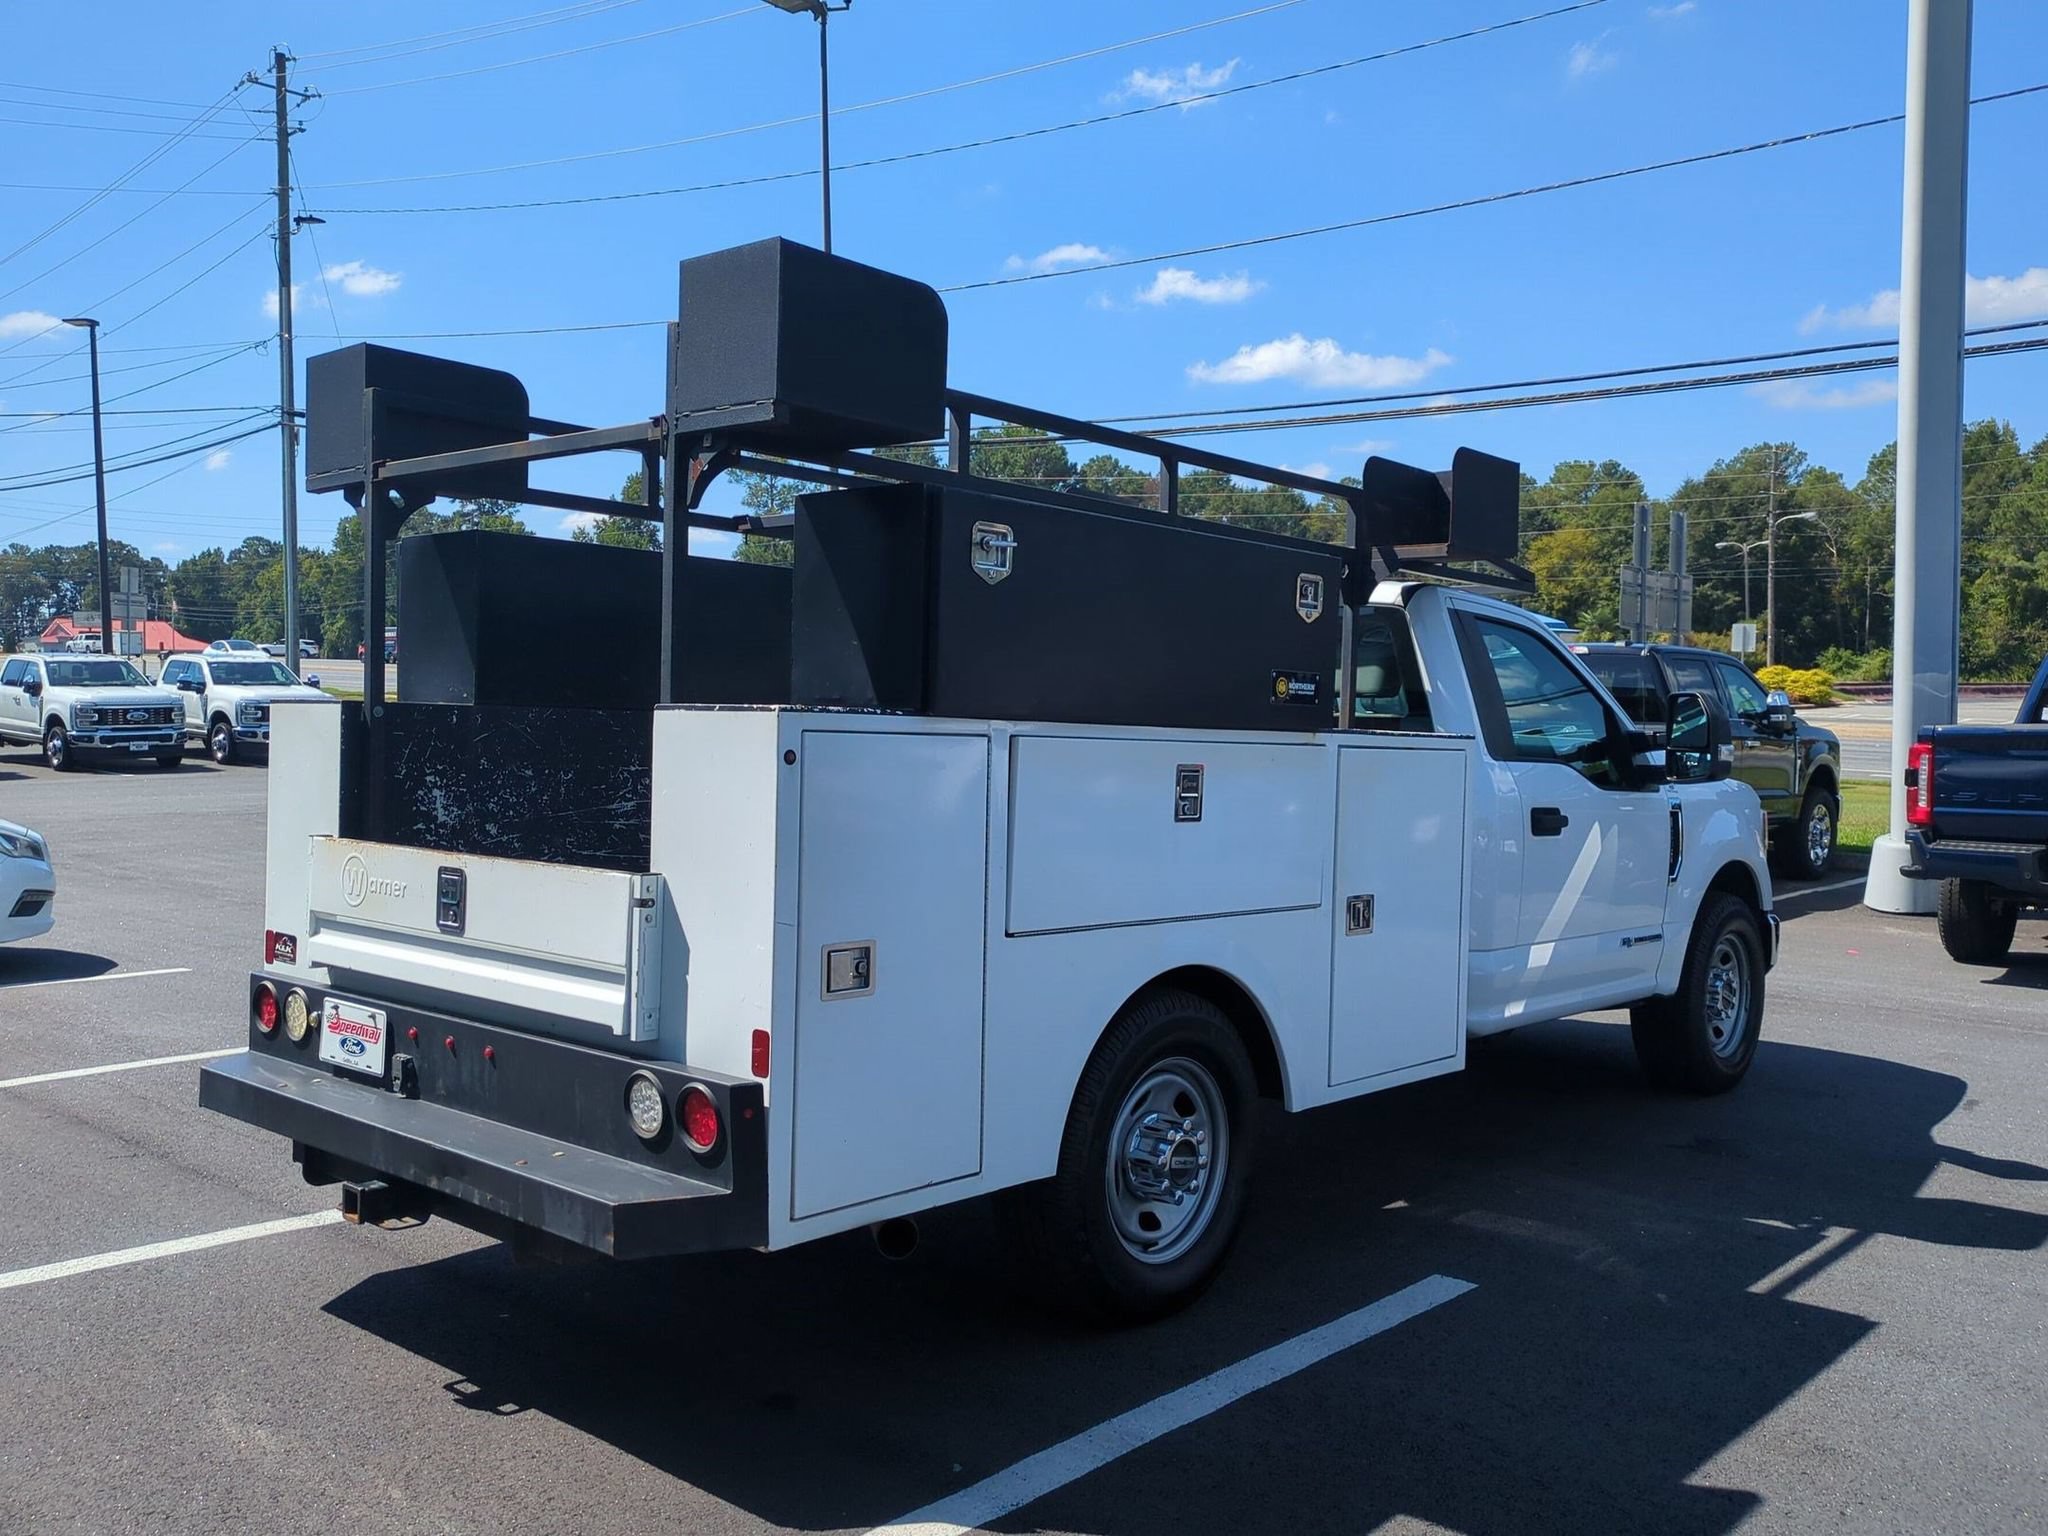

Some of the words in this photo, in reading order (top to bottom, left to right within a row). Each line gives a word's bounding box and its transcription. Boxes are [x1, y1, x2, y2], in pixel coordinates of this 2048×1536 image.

[343, 860, 407, 903] Warner
[327, 1009, 382, 1046] Speedway
[343, 1036, 363, 1054] Ford
